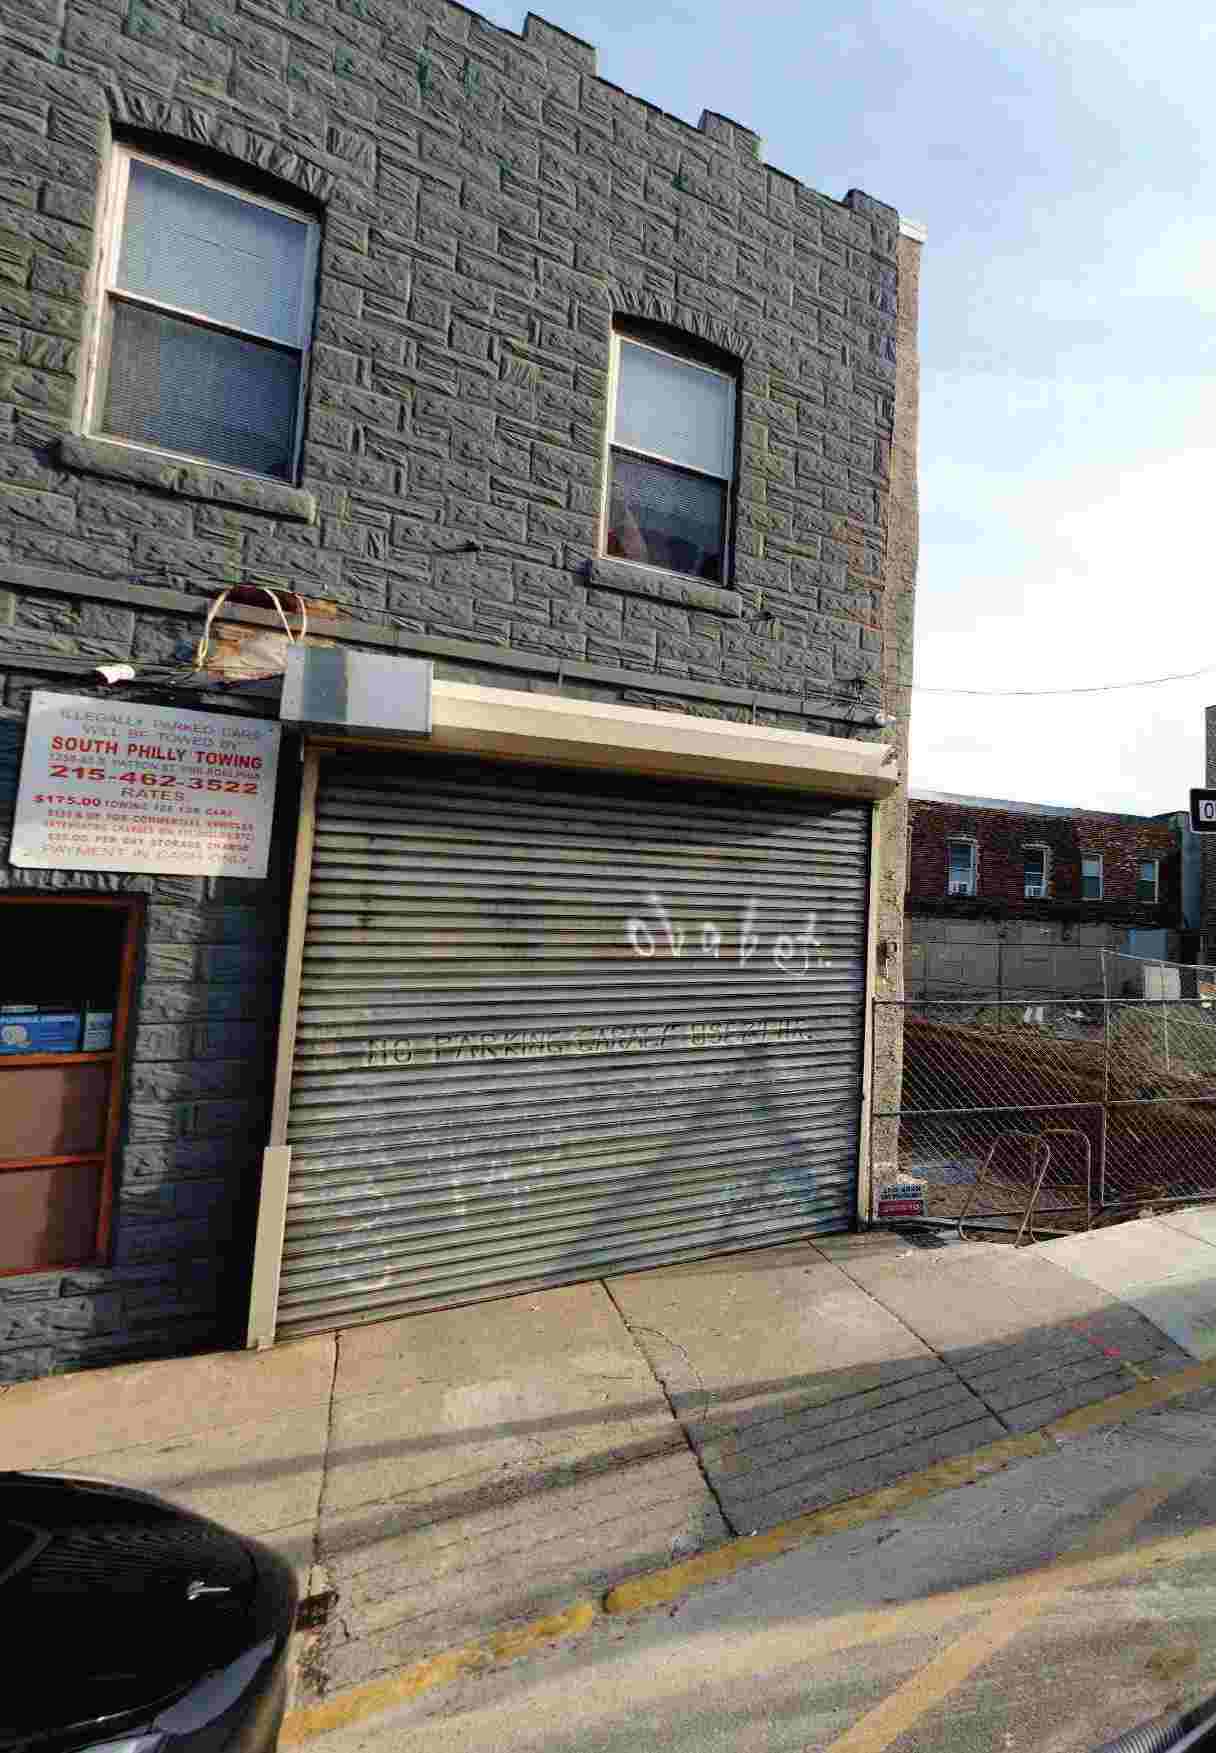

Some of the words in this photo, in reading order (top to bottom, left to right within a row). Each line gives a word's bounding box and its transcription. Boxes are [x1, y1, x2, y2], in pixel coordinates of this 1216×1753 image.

[152, 719, 214, 736] PARKED
[158, 732, 213, 748] TOWED
[52, 736, 118, 755] SOUTH
[128, 743, 185, 763] PHILLY
[195, 751, 263, 769] TOWING
[49, 765, 258, 794] 215-462-3522
[33, 793, 101, 808] $175.00
[120, 787, 185, 802] RATES
[368, 1038, 413, 1065] NO
[433, 1030, 565, 1063] PARKING
